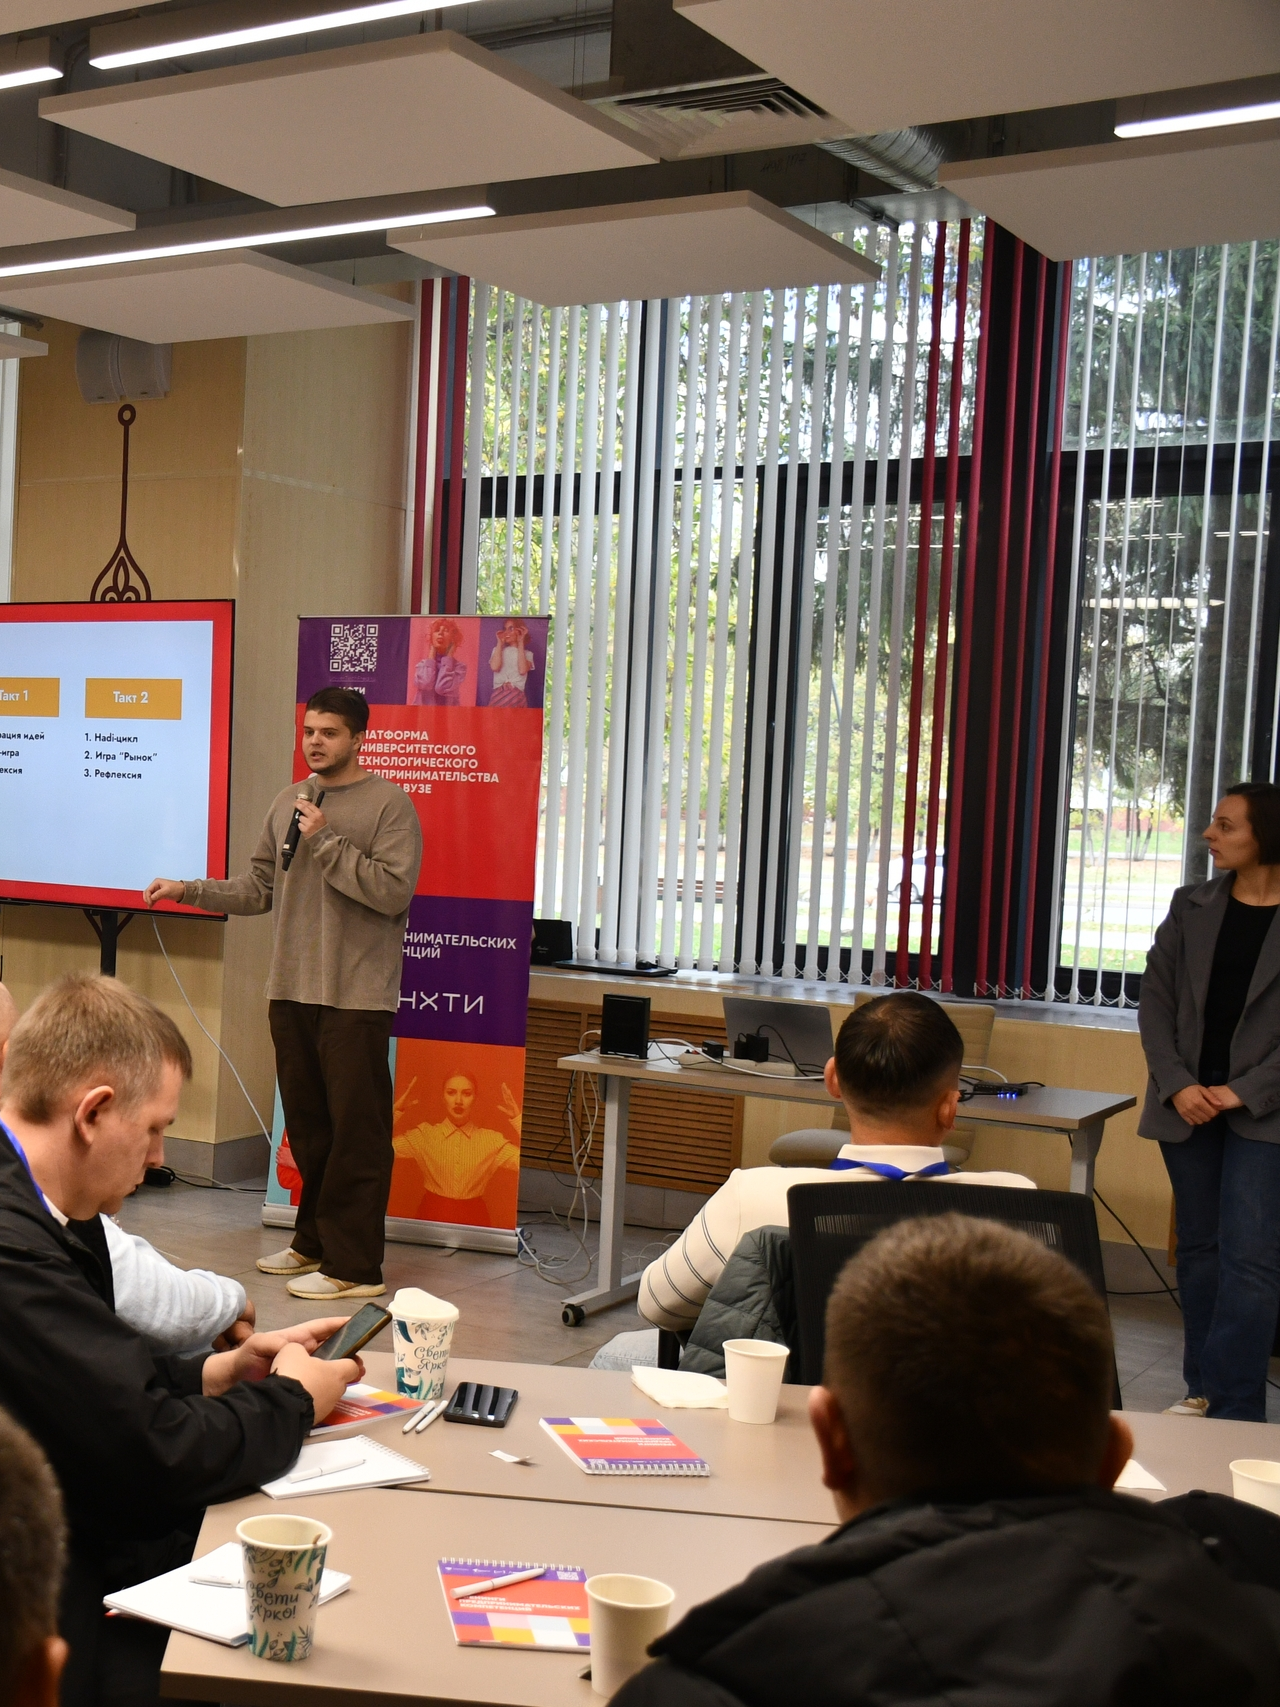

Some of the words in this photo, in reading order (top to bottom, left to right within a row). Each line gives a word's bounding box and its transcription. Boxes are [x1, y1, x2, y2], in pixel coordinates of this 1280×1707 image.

[23, 690, 29, 701] 1
[113, 691, 137, 703] Такт
[140, 691, 149, 704] 2
[23, 731, 45, 741] идей
[84, 733, 92, 742] 1.
[94, 732, 138, 743] Hadi-цикл
[84, 750, 93, 760] 2.
[95, 751, 117, 762] Игра
[360, 743, 476, 756] НИВЕРСИТЕТСКОГО
[357, 755, 479, 769] ЕХНОЛОГИЧЕСКОГО
[83, 768, 92, 778] 3.
[94, 769, 142, 780] Рефлексия
[367, 769, 499, 783] ДПРИНИМАТЕЛЬСТВА
[404, 931, 517, 950] НИМАТЕЛЬСКИХ
[402, 944, 441, 960] НЦИЙ
[414, 1345, 449, 1361] Свет
[246, 1580, 299, 1605] Свети
[250, 1599, 297, 1622] Ярко!
